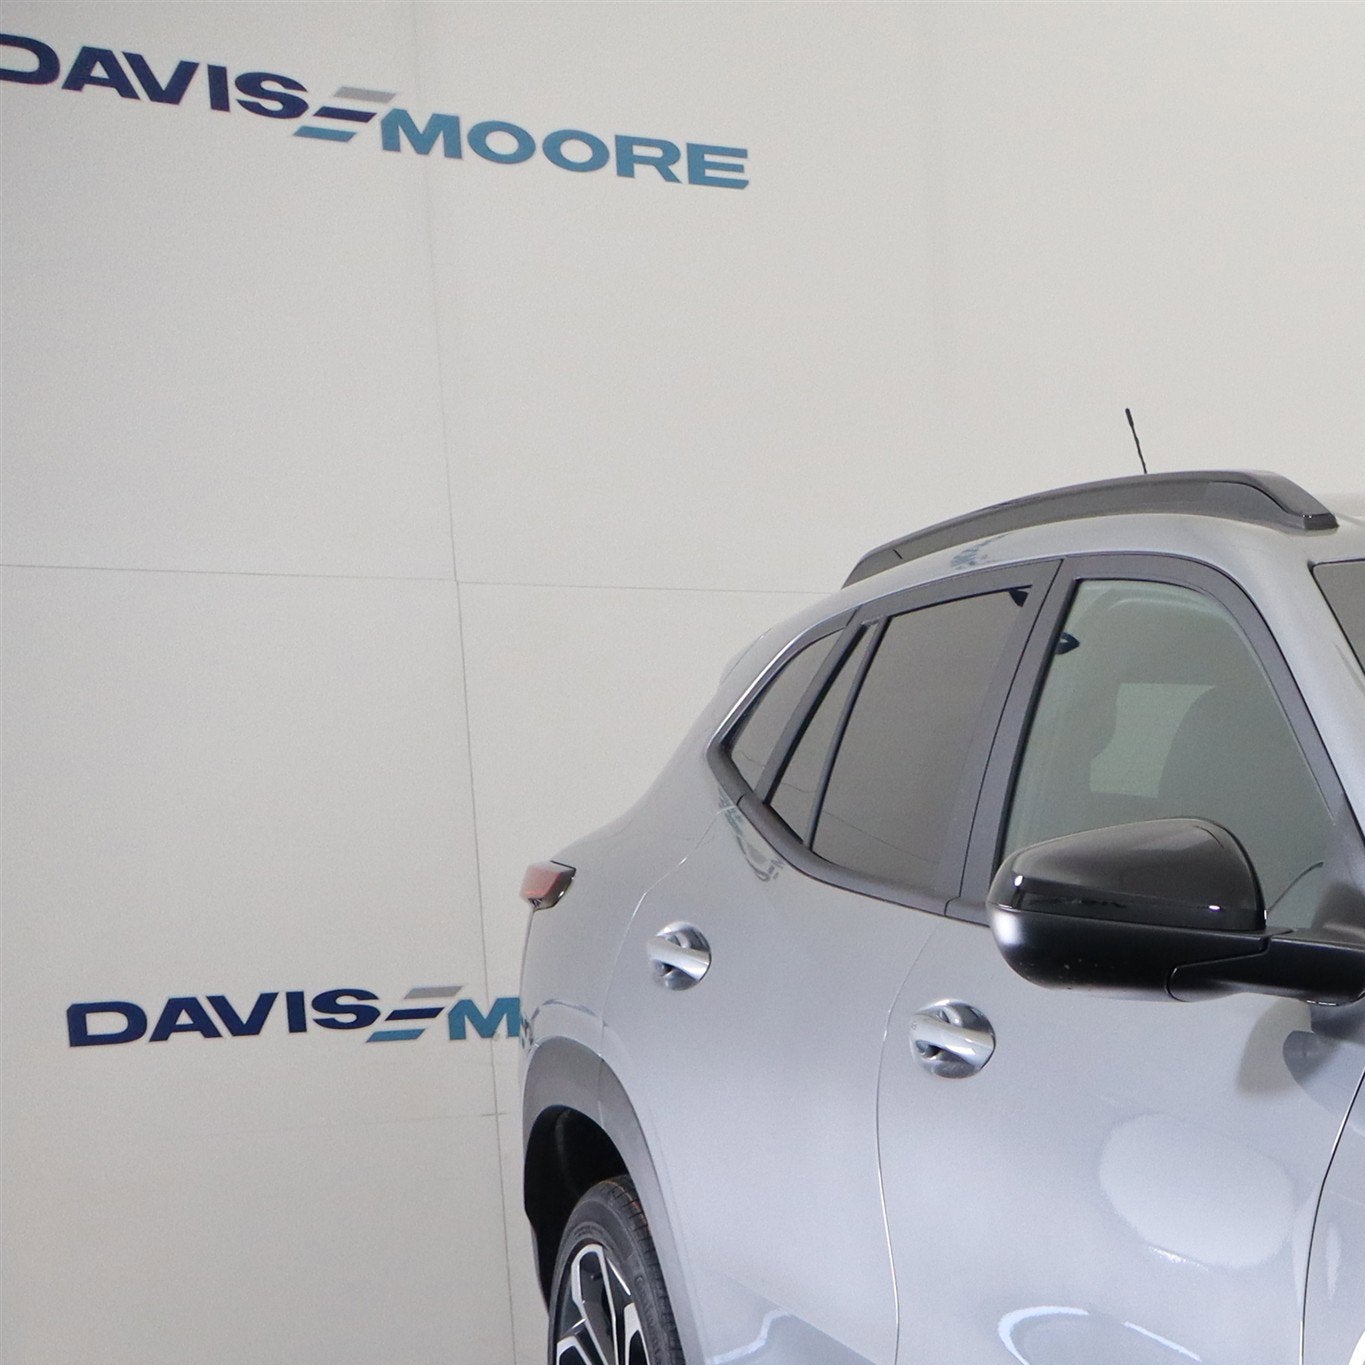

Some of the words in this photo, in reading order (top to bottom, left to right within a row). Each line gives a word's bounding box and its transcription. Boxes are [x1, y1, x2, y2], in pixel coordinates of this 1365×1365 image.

[0, 33, 310, 120] DAVIS
[379, 108, 750, 190] MOORE
[66, 987, 381, 1048] DAVIS
